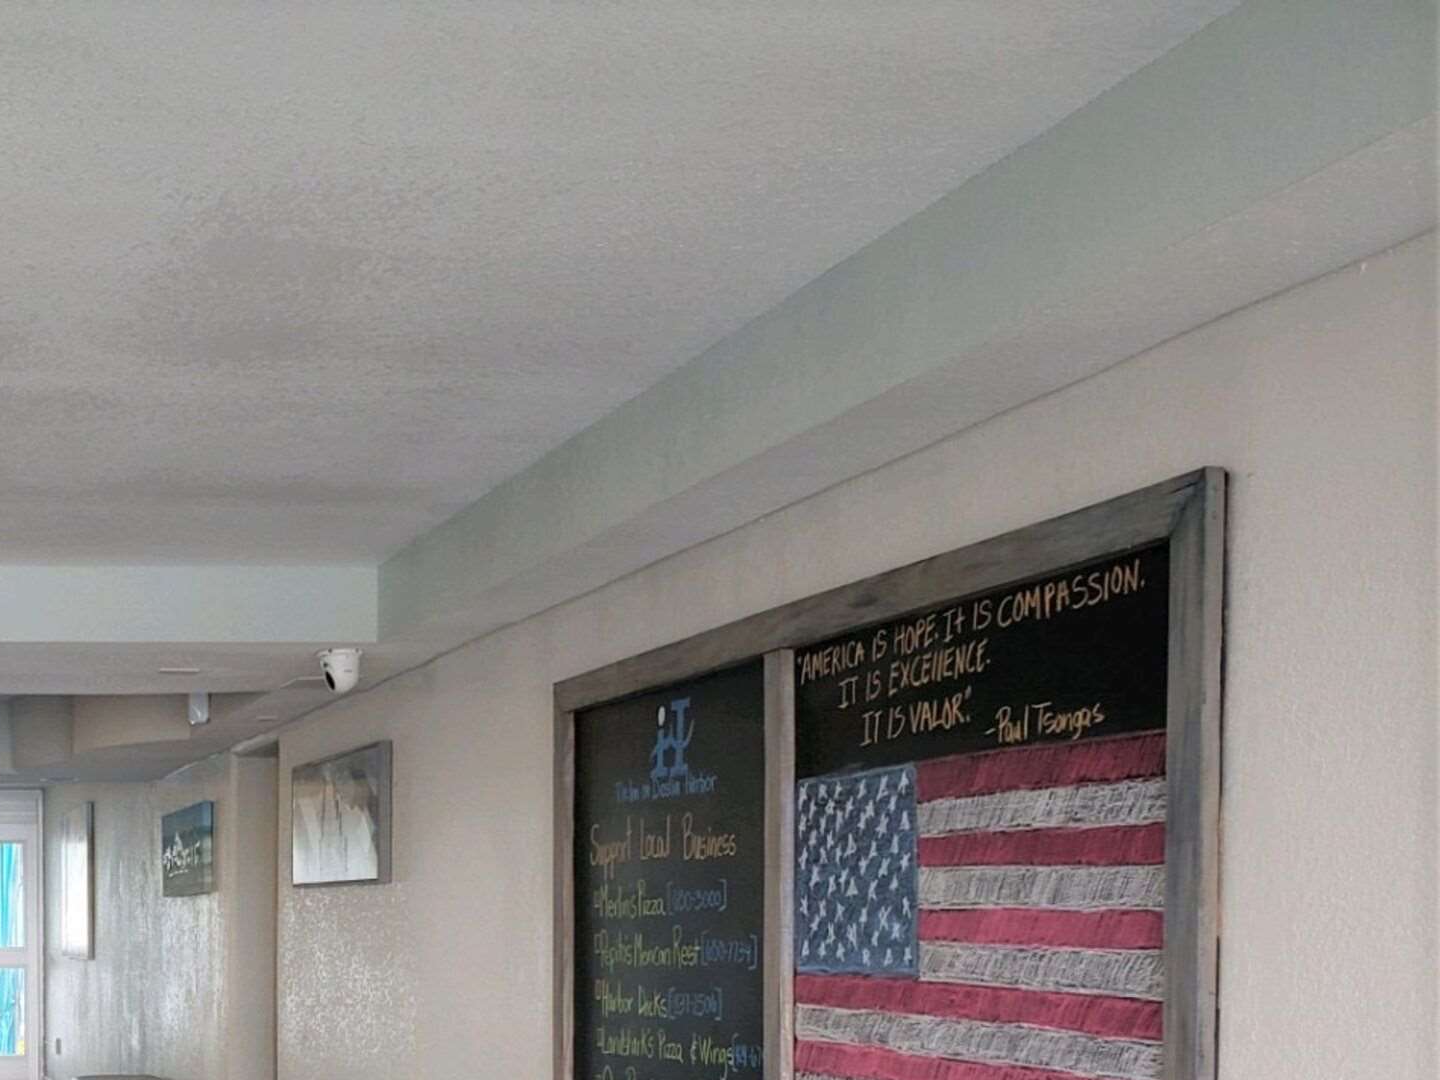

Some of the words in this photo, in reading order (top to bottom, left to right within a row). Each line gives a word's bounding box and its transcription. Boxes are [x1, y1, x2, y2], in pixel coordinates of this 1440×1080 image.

[872, 629, 887, 663] IS
[893, 613, 939, 656] HOPE.
[972, 601, 993, 631] IS
[997, 559, 1146, 629] COMPASSION.
[838, 675, 859, 709] IT
[865, 669, 881, 703] IS
[859, 709, 882, 747] IT
[887, 705, 906, 740] IS
[590, 816, 633, 880] Support
[640, 813, 670, 860] Local
[682, 811, 737, 861] Business
